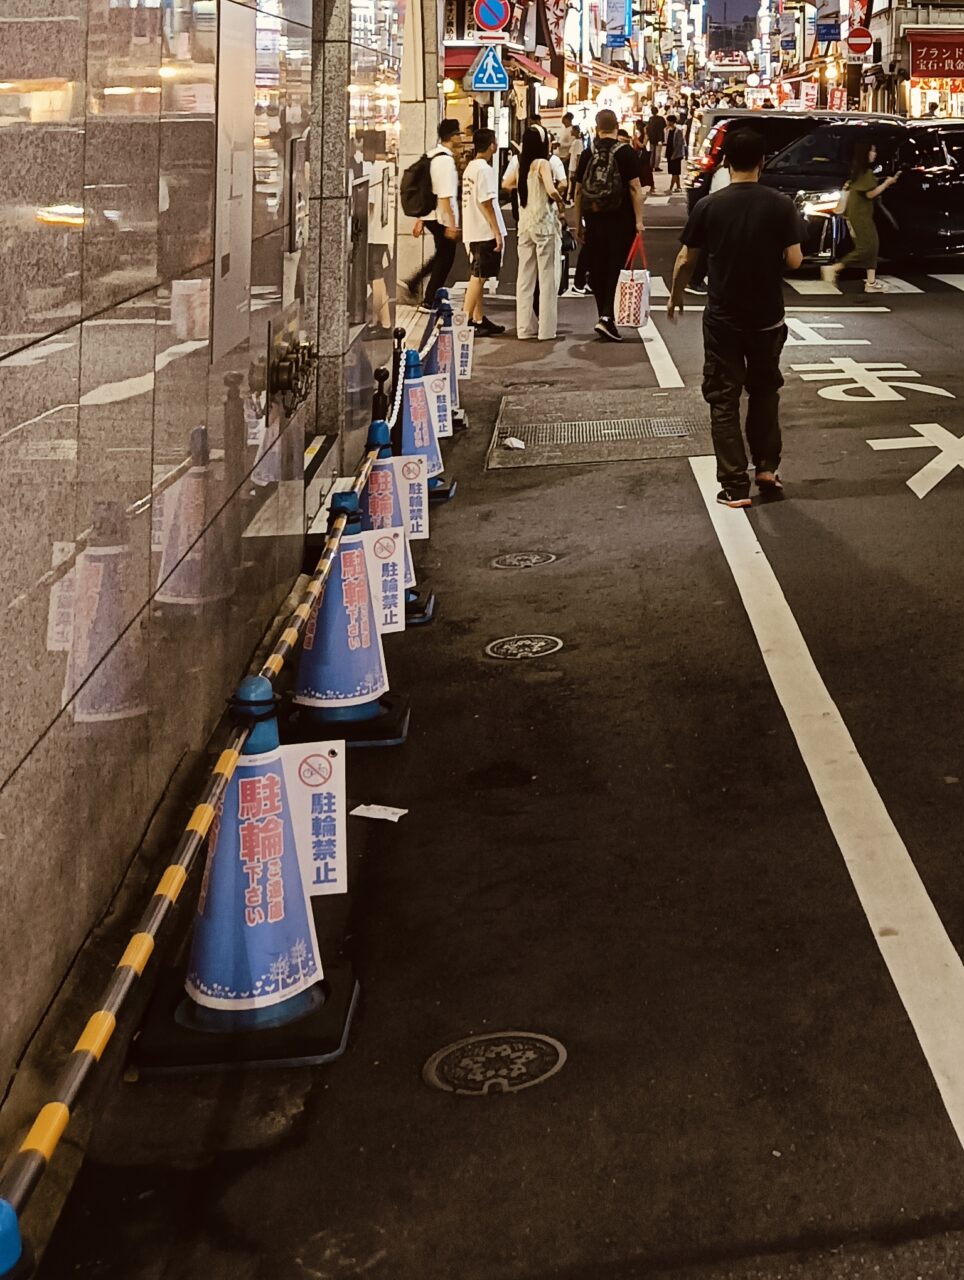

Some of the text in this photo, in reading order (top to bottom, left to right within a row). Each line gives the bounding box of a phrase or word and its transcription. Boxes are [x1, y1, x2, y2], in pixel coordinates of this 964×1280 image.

[409, 482, 423, 534] 駐輪禁止
[382, 562, 398, 626] 駐輪禁止
[239, 773, 284, 862] 駐輪
[311, 792, 338, 885] 駐輪禁止
